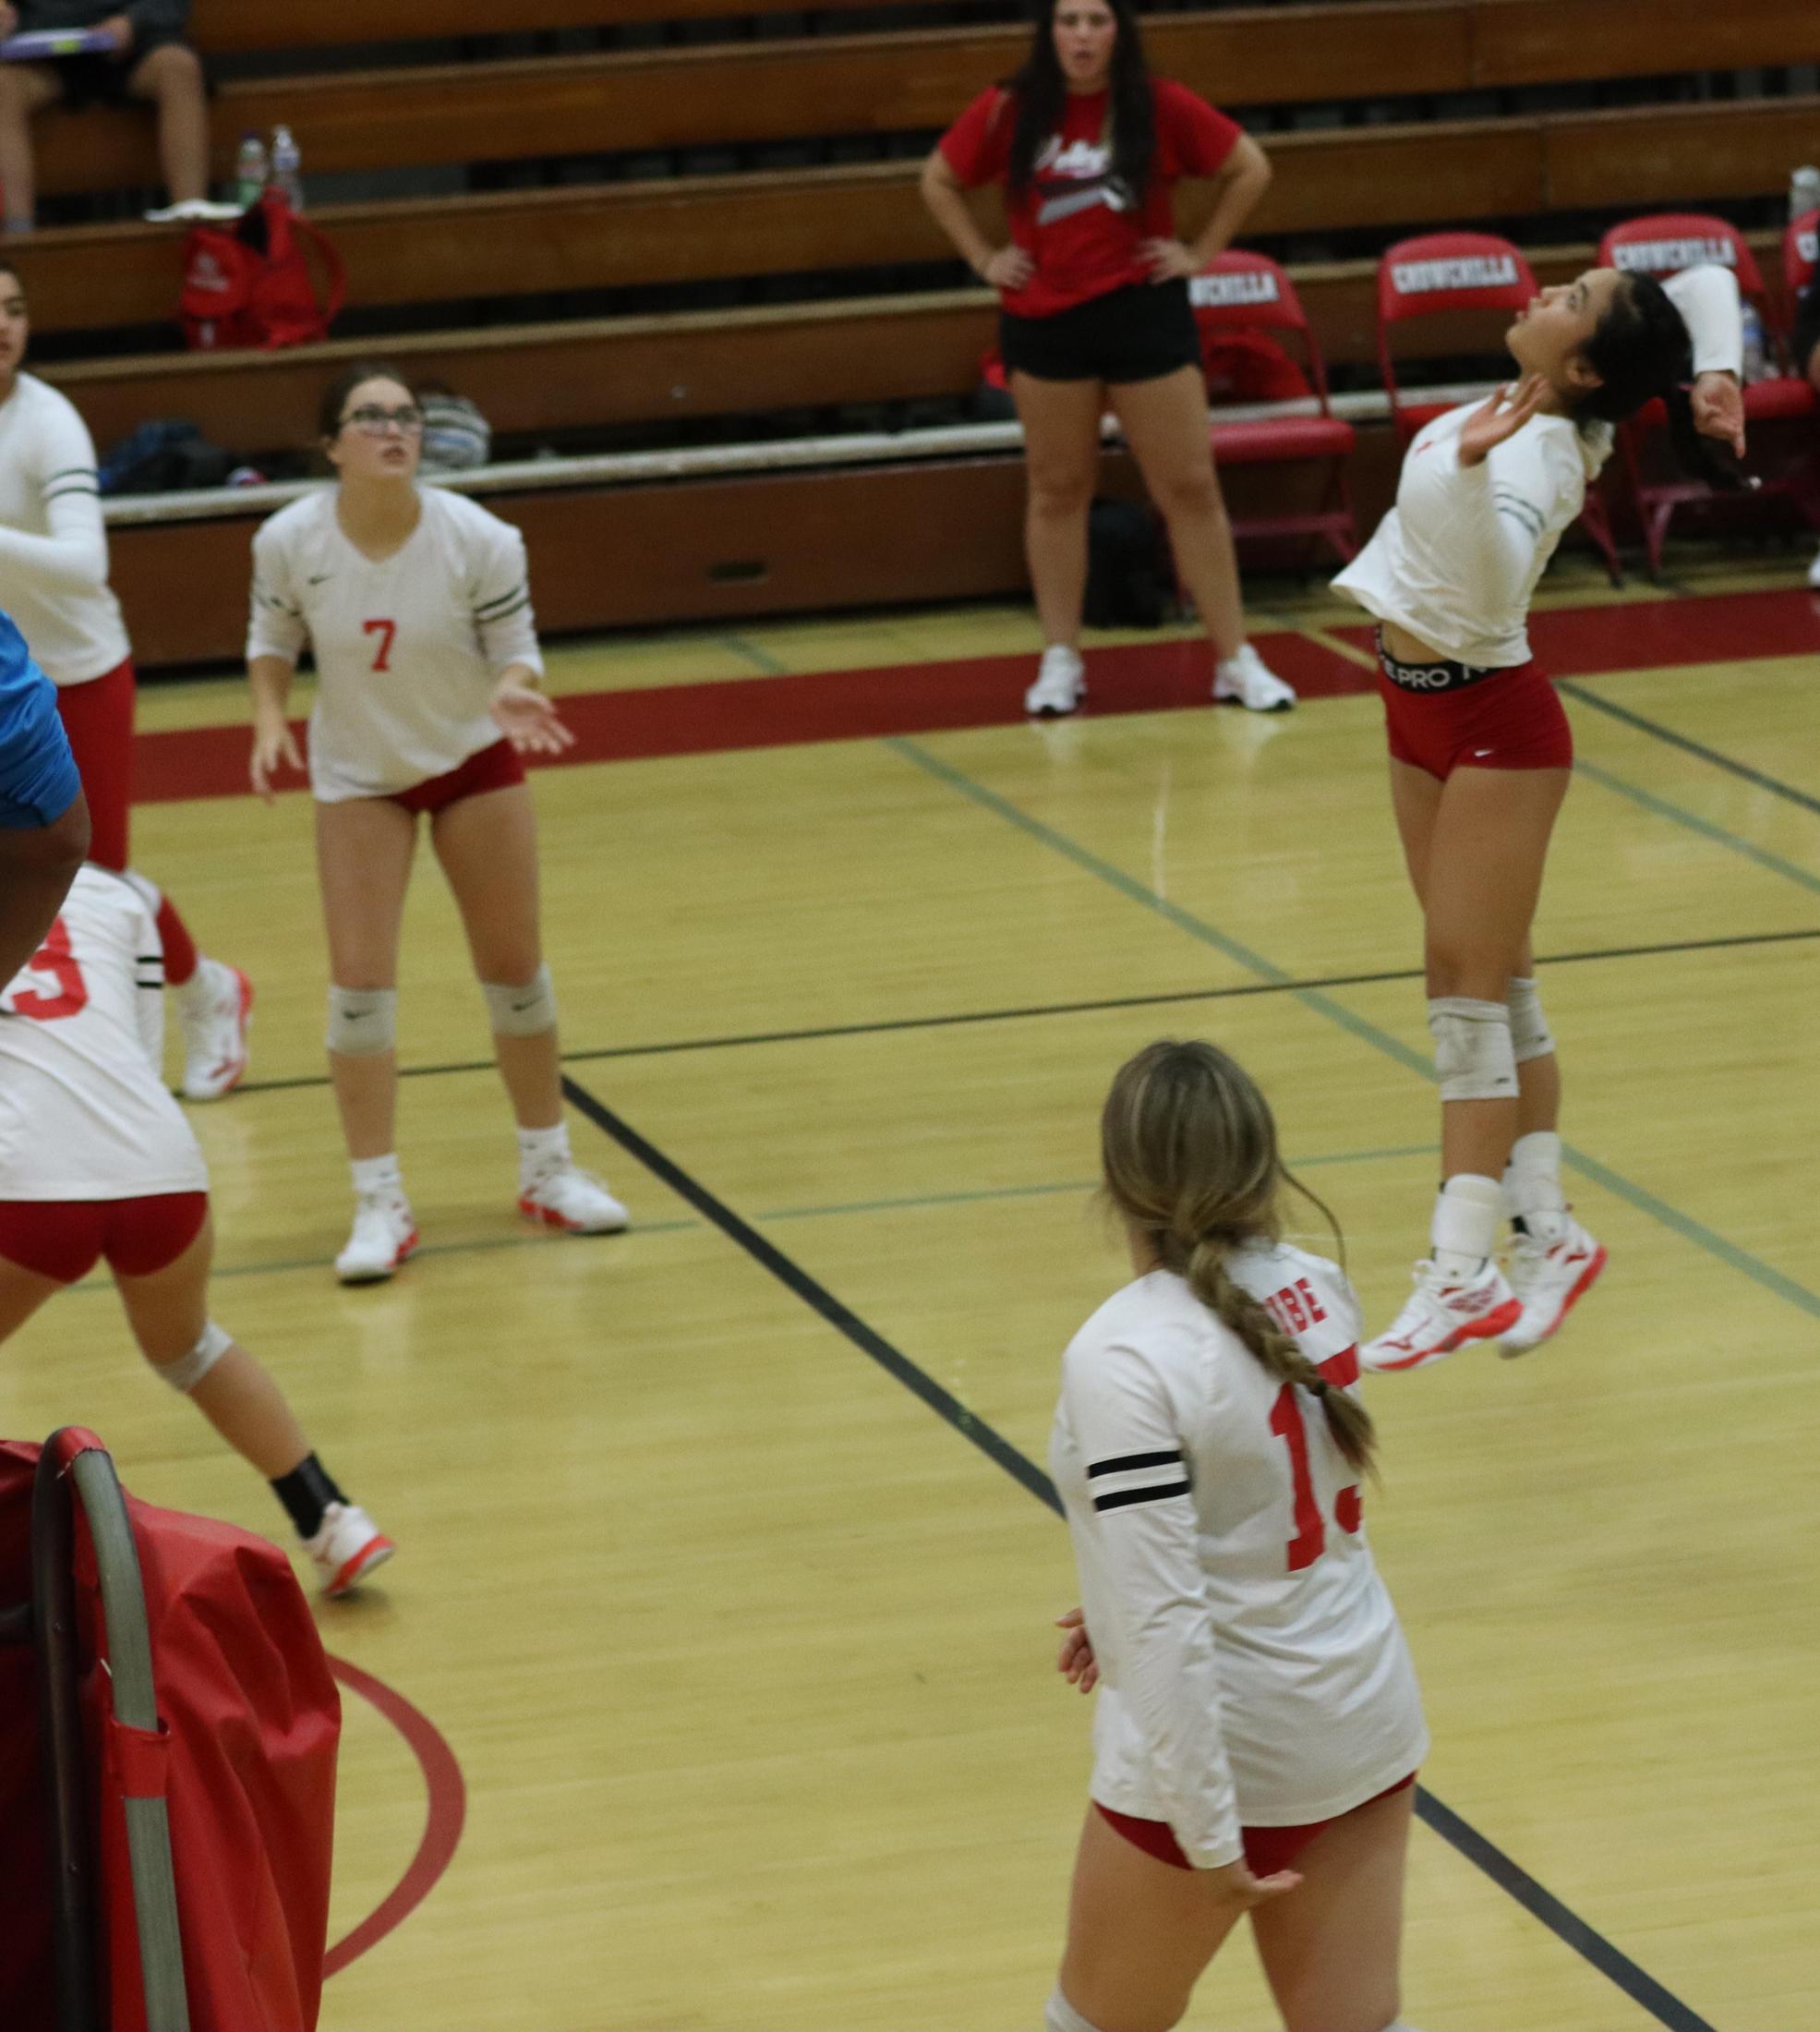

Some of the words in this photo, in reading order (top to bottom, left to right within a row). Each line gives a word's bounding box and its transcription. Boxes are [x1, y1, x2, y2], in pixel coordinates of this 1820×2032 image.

[361, 620, 396, 672] 7
[1397, 667, 1451, 689] PRO
[1264, 1276, 1330, 1337] IBE
